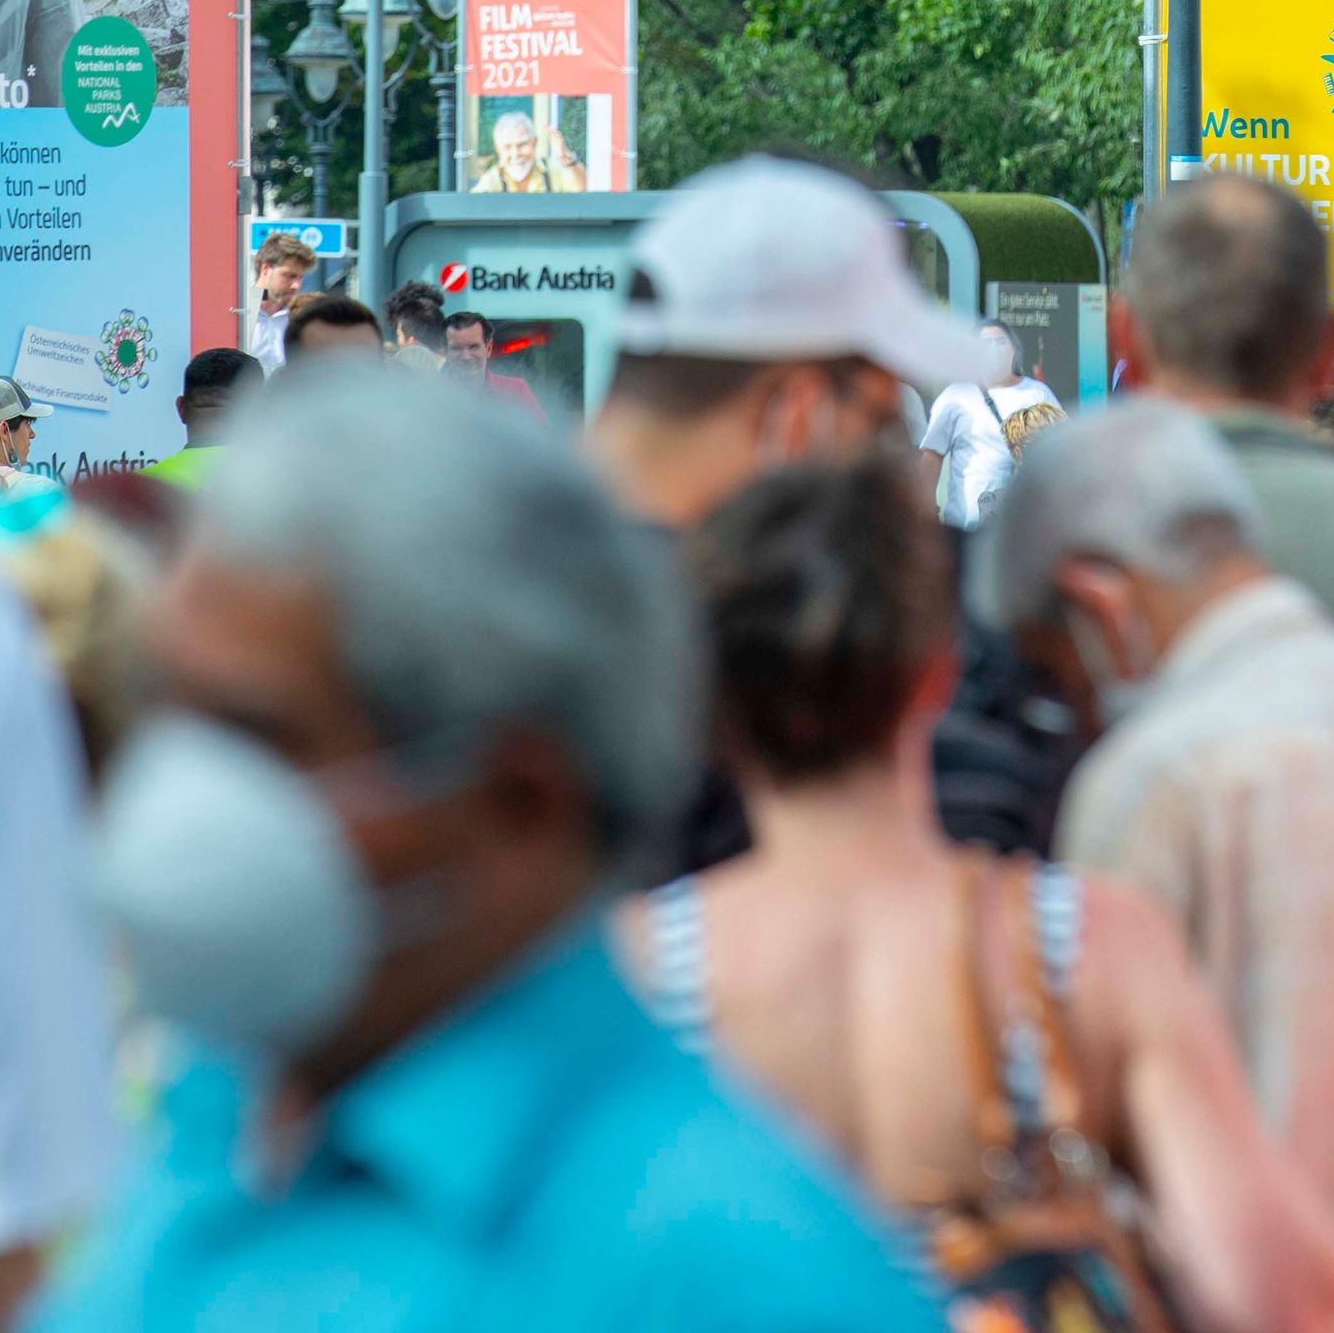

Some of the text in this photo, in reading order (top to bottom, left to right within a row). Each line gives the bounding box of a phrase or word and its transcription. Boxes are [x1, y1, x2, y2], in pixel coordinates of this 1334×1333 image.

[479, 3, 532, 32] FILM
[481, 29, 584, 60] FESTIVAL
[126, 60, 143, 72] den
[481, 60, 539, 90] 2021
[78, 77, 121, 88] NATIONAL
[92, 89, 122, 100] PARKS
[85, 102, 121, 113] AUSTRIA
[1, 141, 61, 165] können
[6, 177, 33, 197] tun
[54, 174, 86, 196] und
[7, 207, 82, 229] Vorteilen
[472, 265, 615, 291] Bank Austria
